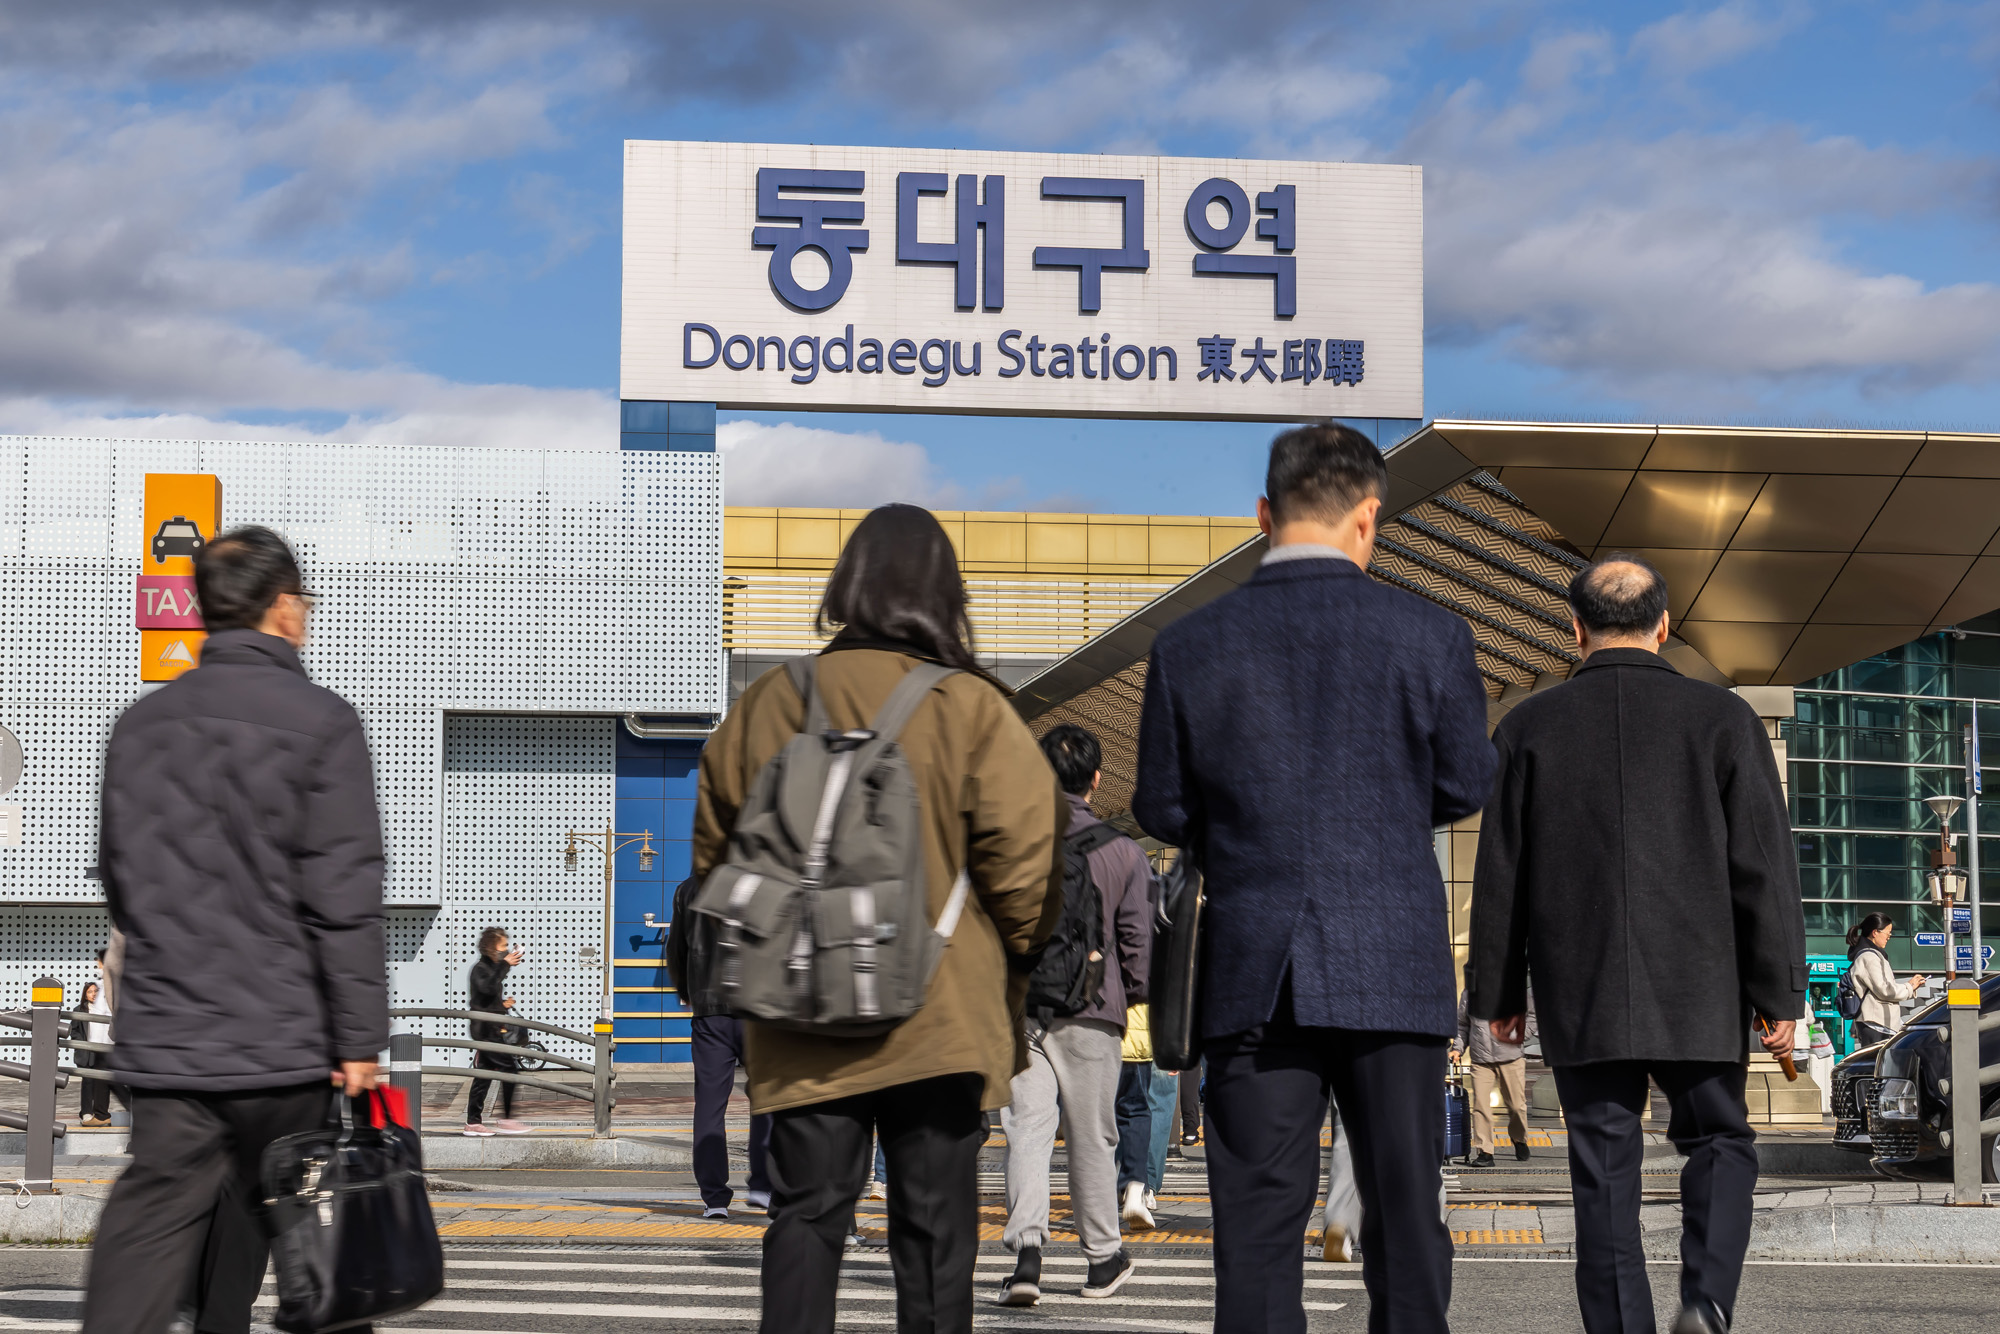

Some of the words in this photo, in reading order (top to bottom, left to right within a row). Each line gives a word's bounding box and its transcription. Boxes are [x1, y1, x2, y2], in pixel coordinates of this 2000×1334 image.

[752, 167, 1297, 319] 동대구역
[683, 322, 981, 387] Dongdaegu
[997, 329, 1177, 380] Station
[1197, 334, 1364, 386] 東大邱驛
[140, 587, 202, 616] TAX
